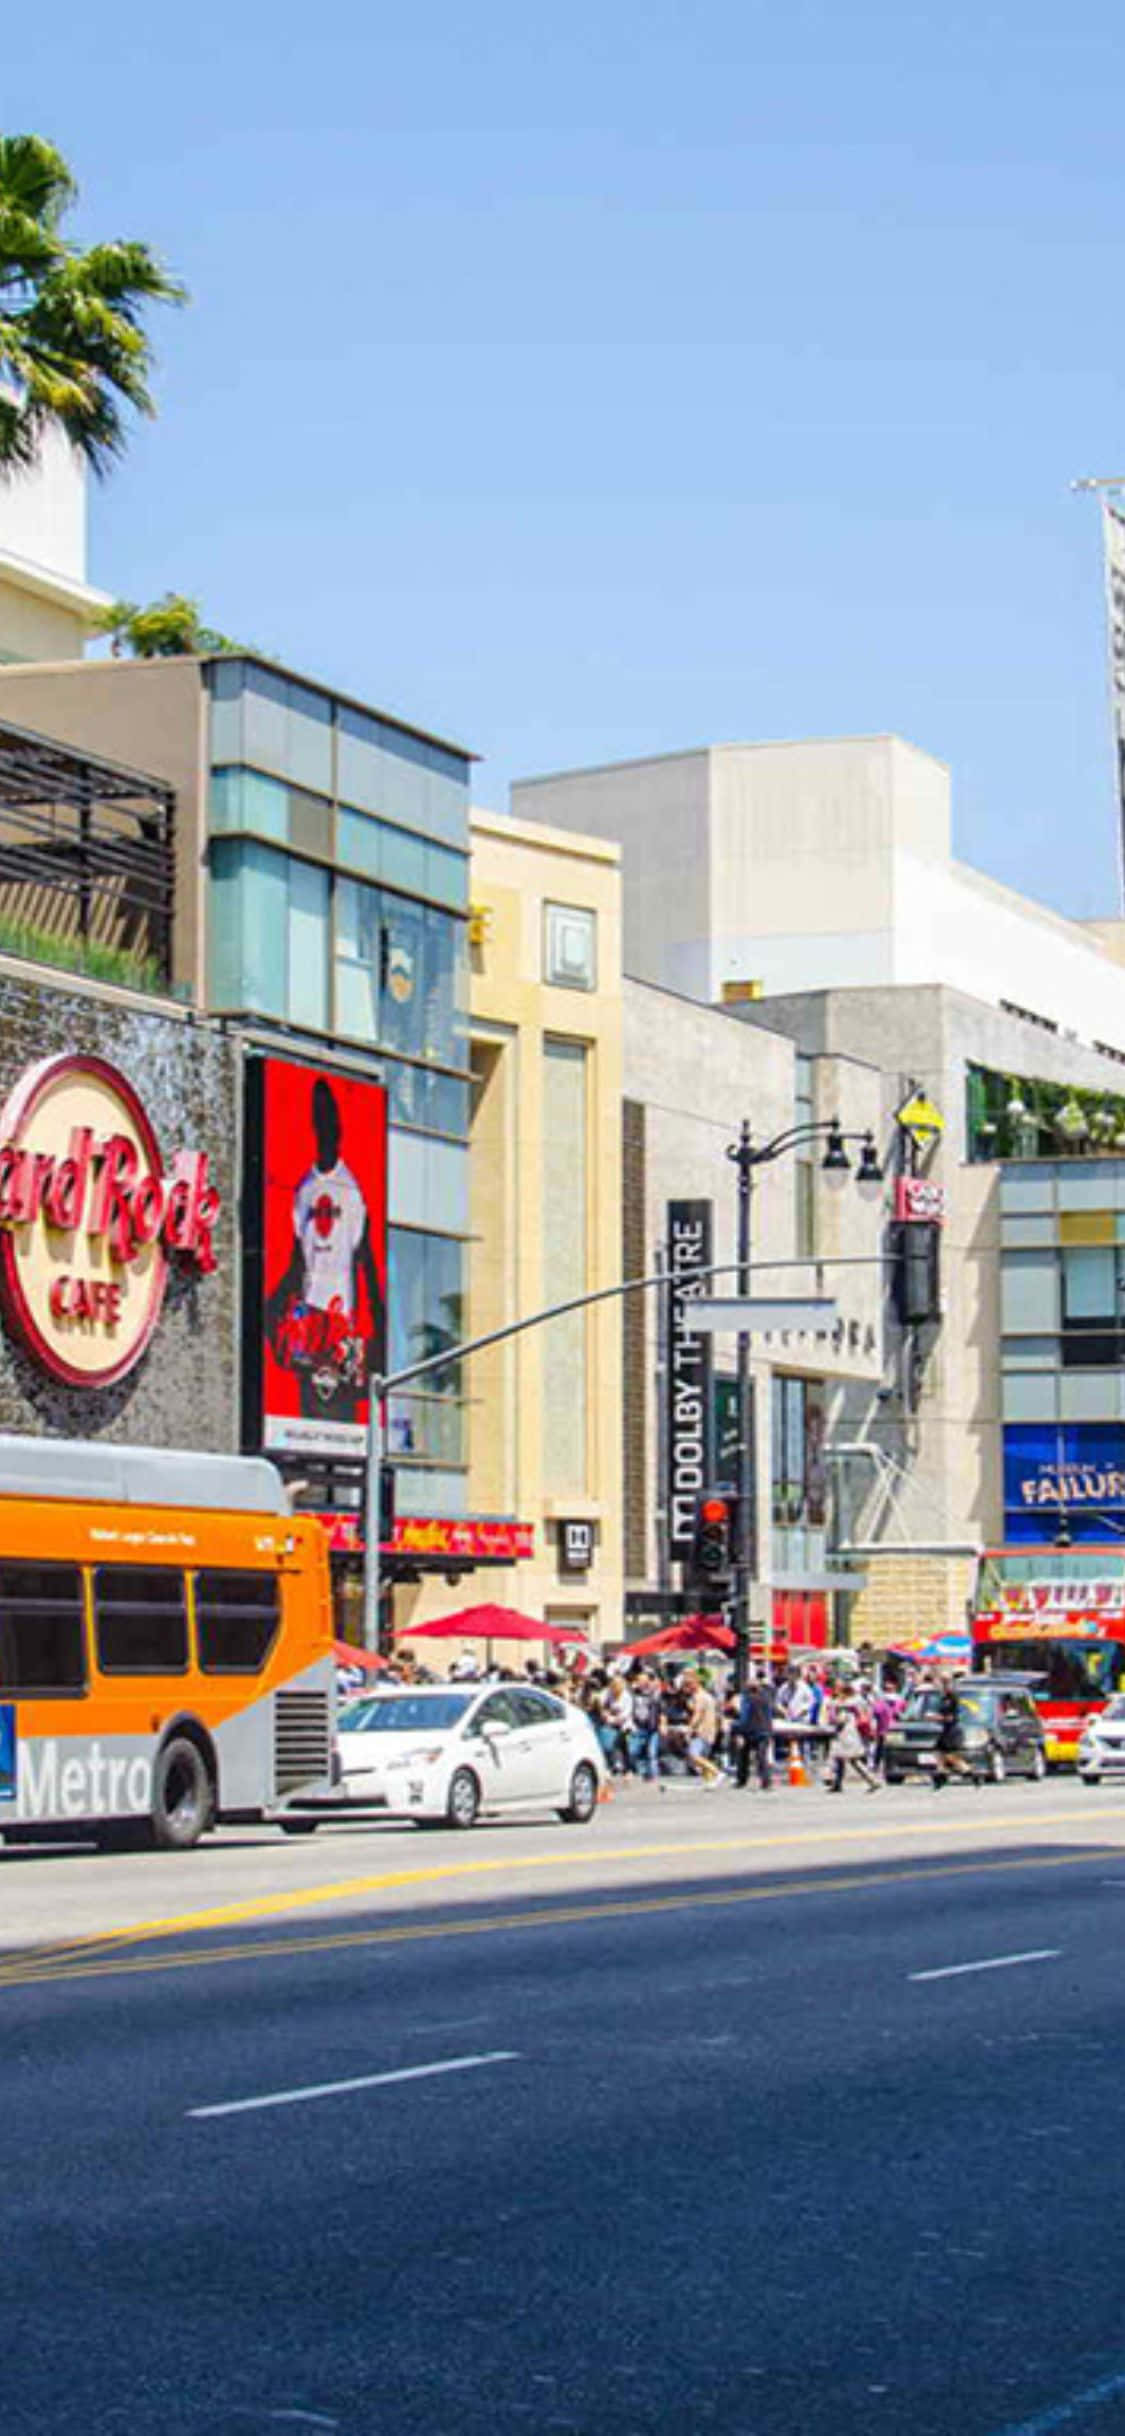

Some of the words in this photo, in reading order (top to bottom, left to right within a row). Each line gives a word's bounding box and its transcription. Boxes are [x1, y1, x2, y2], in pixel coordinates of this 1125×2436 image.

[88, 1135, 220, 1275] Rock
[51, 1275, 121, 1325] CAFE
[673, 1379, 704, 1489] DOLBY
[17, 1738, 152, 1817] Metro
